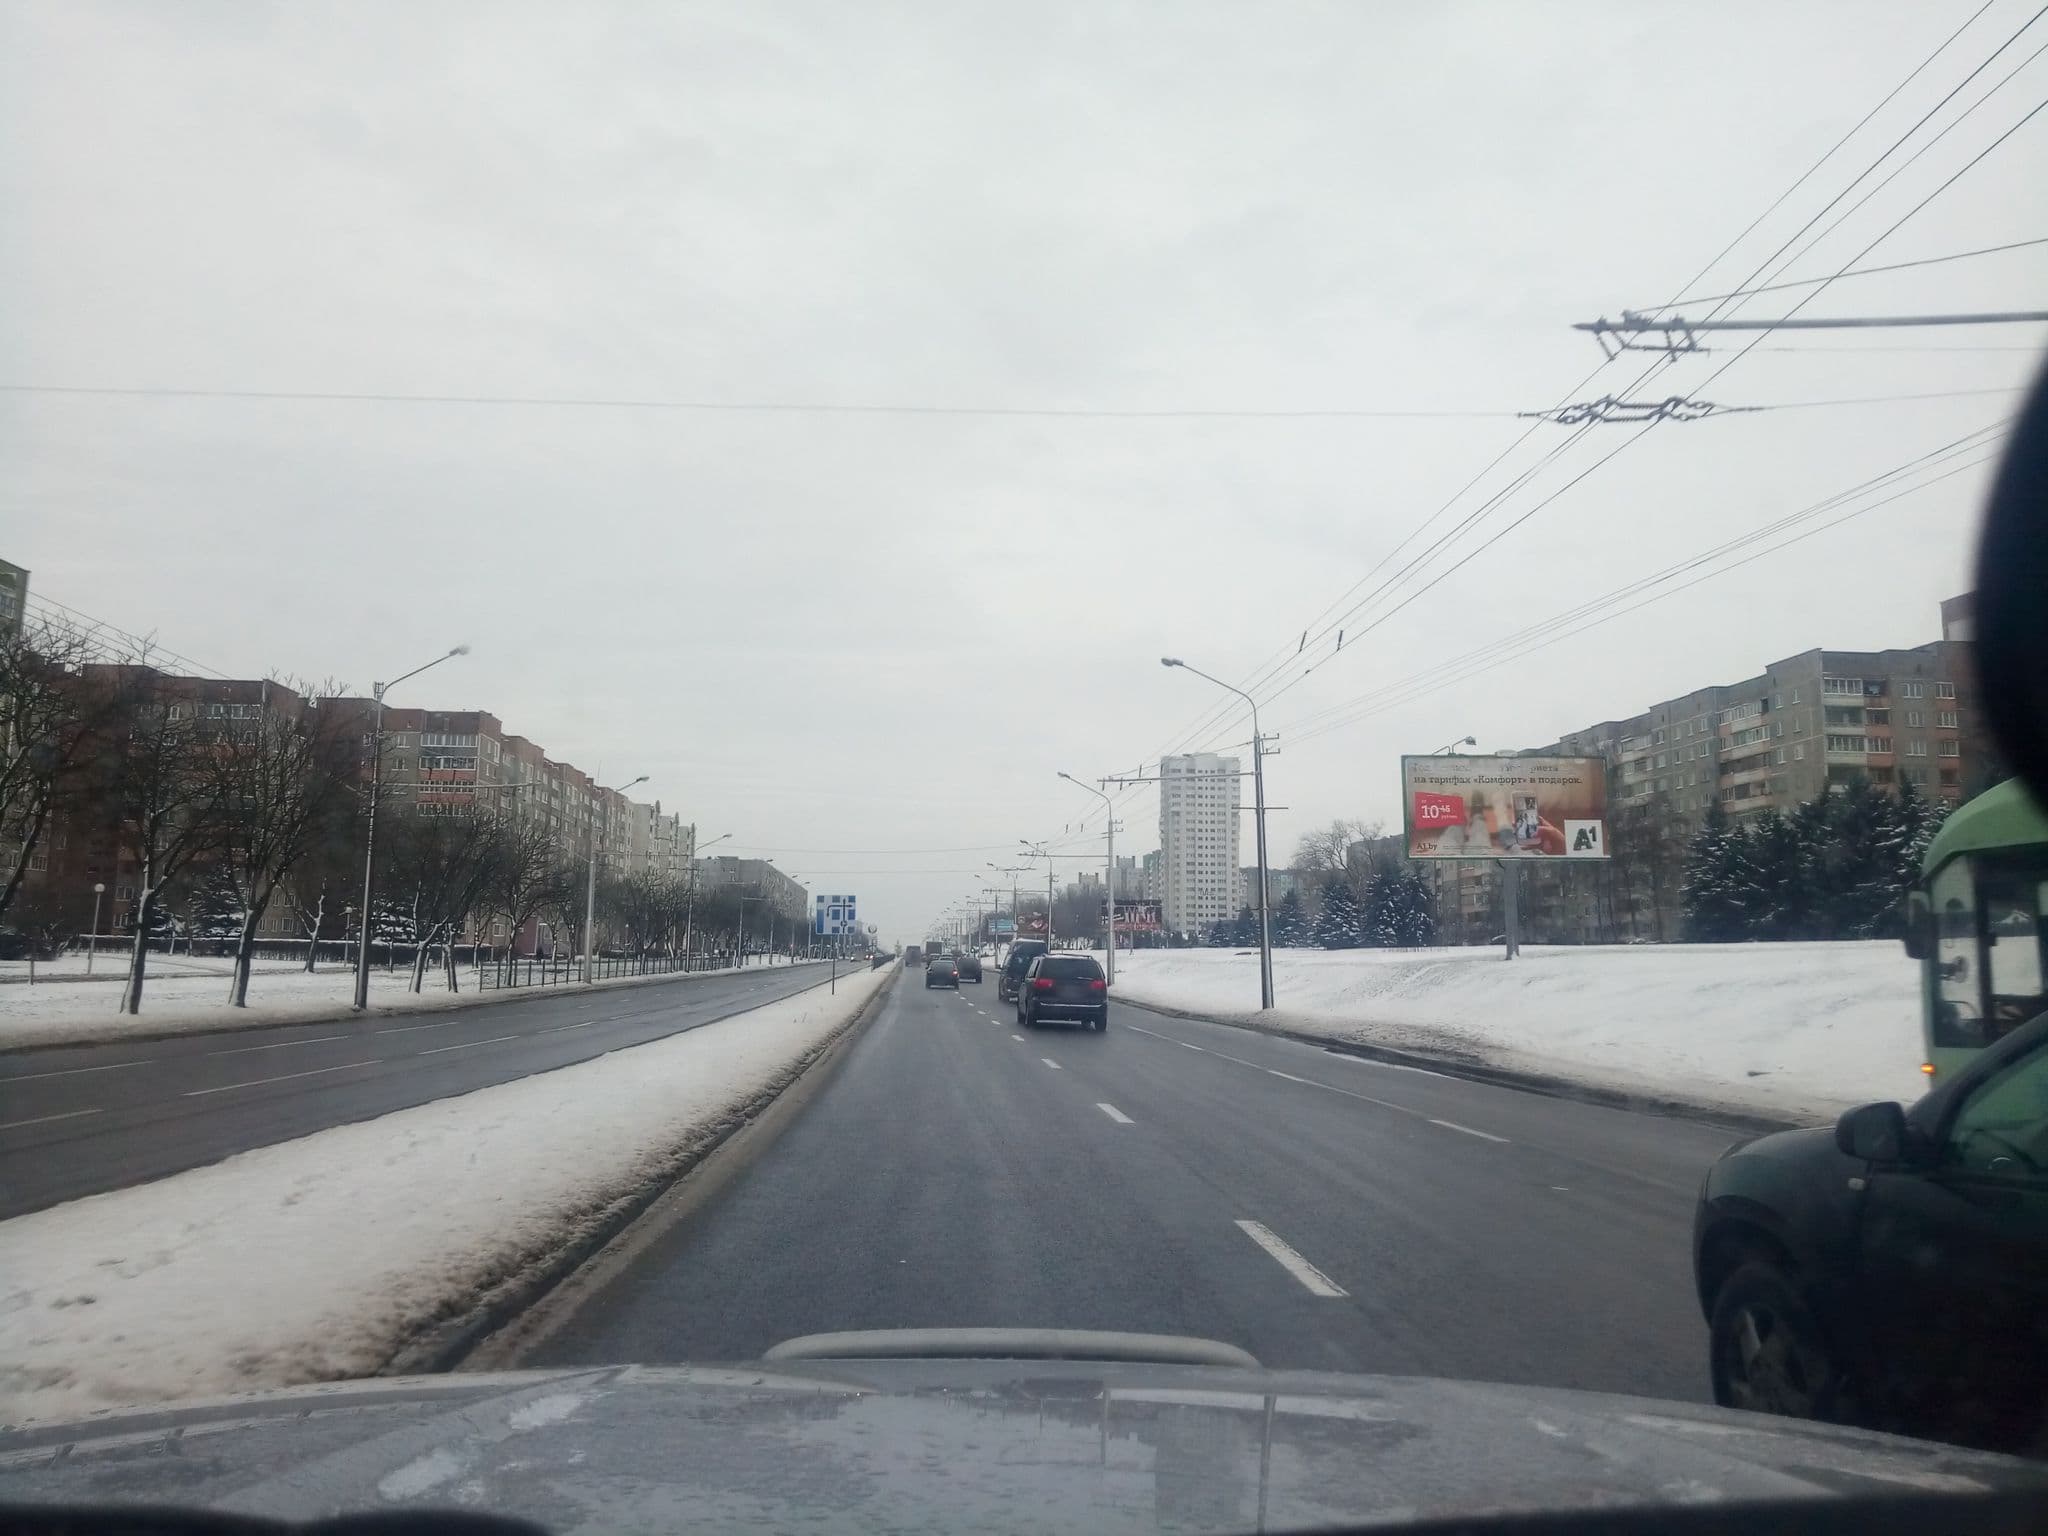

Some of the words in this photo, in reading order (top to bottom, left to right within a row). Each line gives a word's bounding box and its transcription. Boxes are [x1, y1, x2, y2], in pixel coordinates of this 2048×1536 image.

[1414, 776, 1426, 784] на
[1427, 775, 1471, 786] тарифах
[1573, 826, 1597, 851] A1
